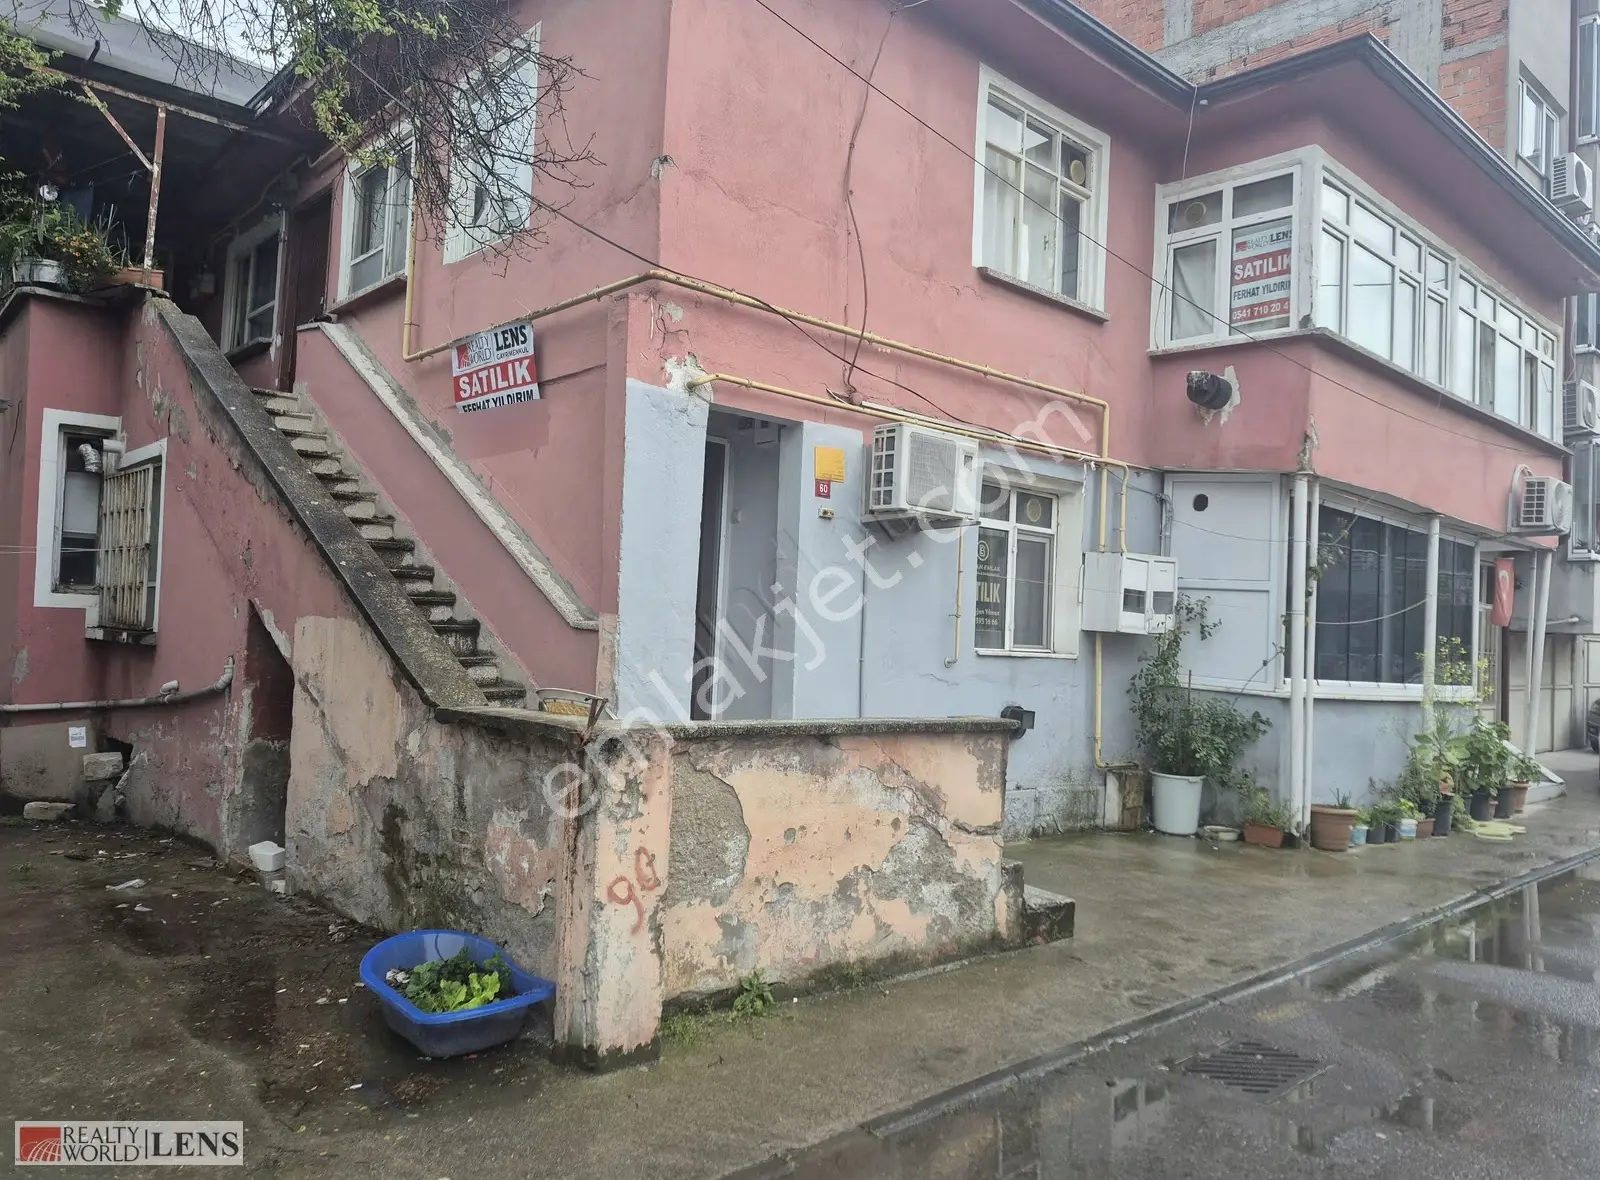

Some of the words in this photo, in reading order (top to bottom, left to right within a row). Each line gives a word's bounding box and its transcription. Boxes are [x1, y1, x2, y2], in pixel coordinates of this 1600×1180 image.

[1233, 286, 1260, 301] FERHAT
[1232, 308, 1251, 320] 0541
[1254, 305, 1269, 317] 710
[1270, 302, 1281, 313] 20
[494, 325, 528, 352] LENS
[459, 359, 532, 399] SATILIK
